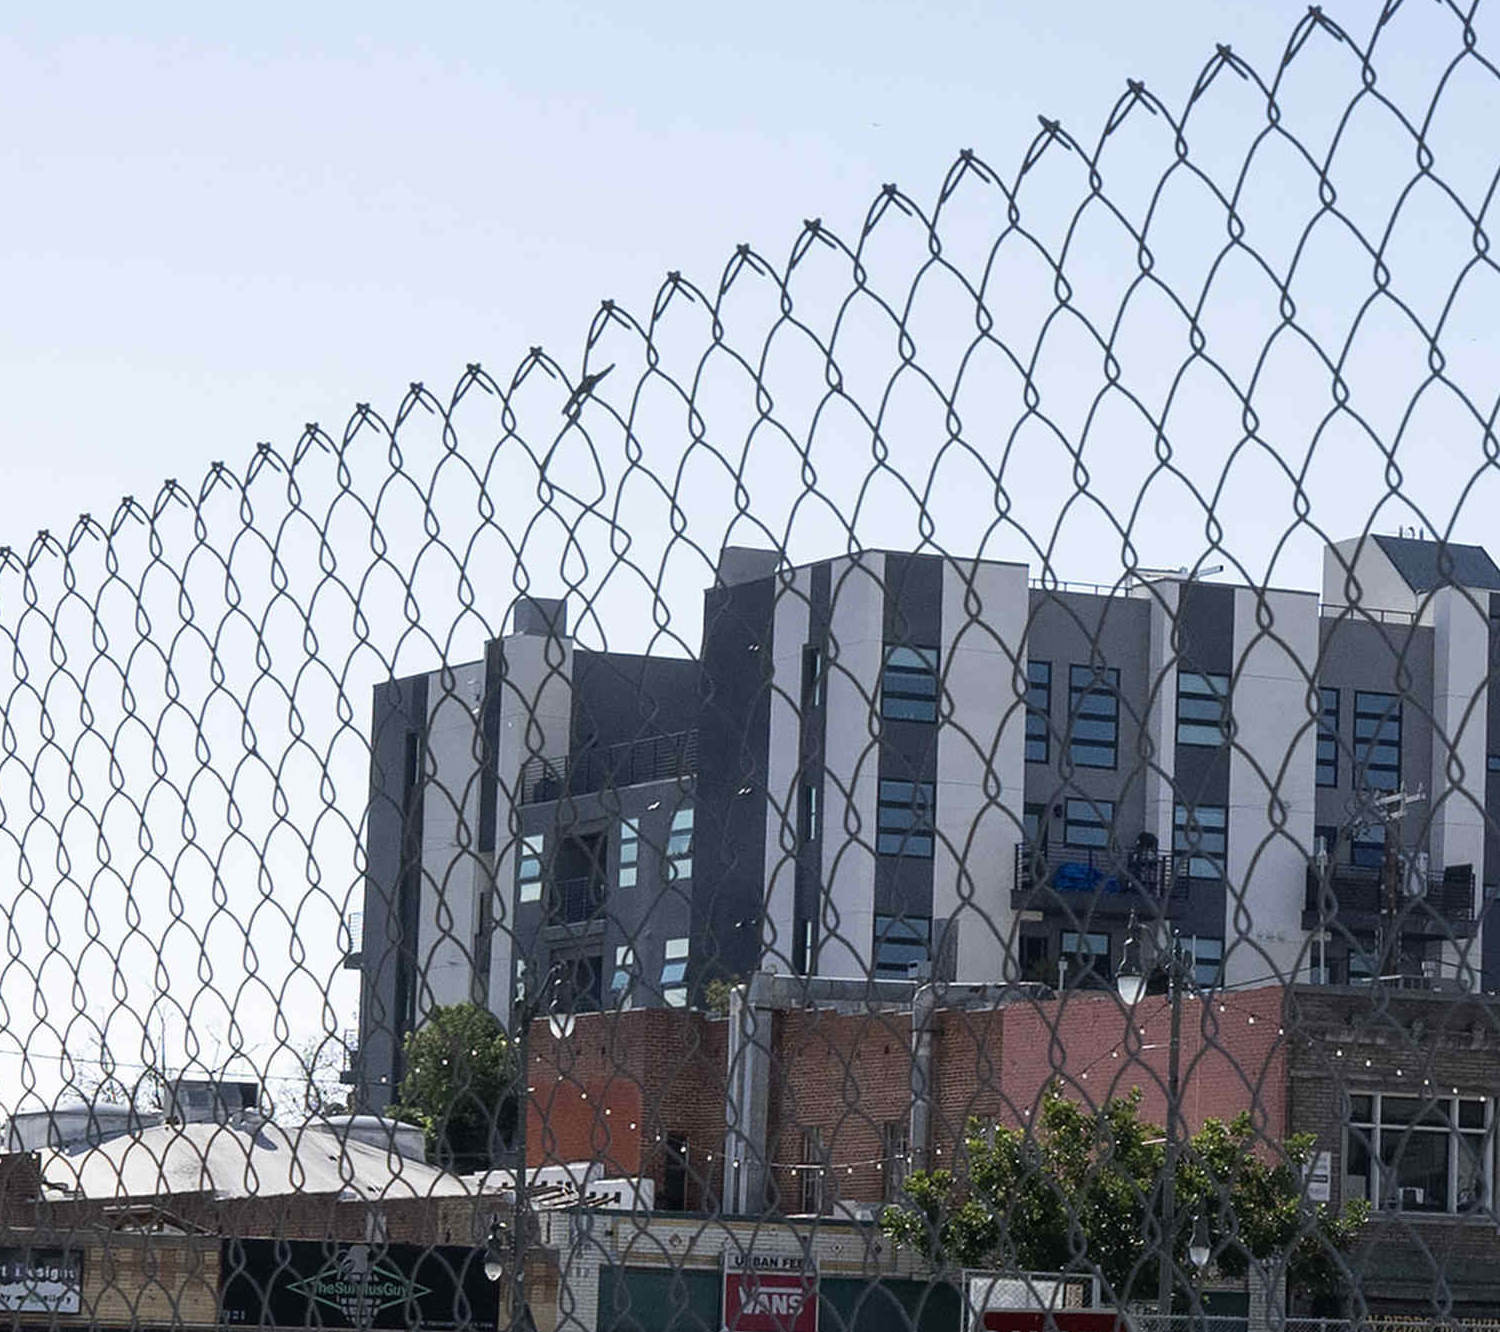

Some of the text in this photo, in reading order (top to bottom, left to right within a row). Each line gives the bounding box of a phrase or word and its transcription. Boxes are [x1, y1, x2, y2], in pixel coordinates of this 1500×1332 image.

[735, 1255, 812, 1269] UBAN FEE
[315, 1281, 409, 1298] TheSurlusGuy
[738, 1286, 804, 1315] VANS
